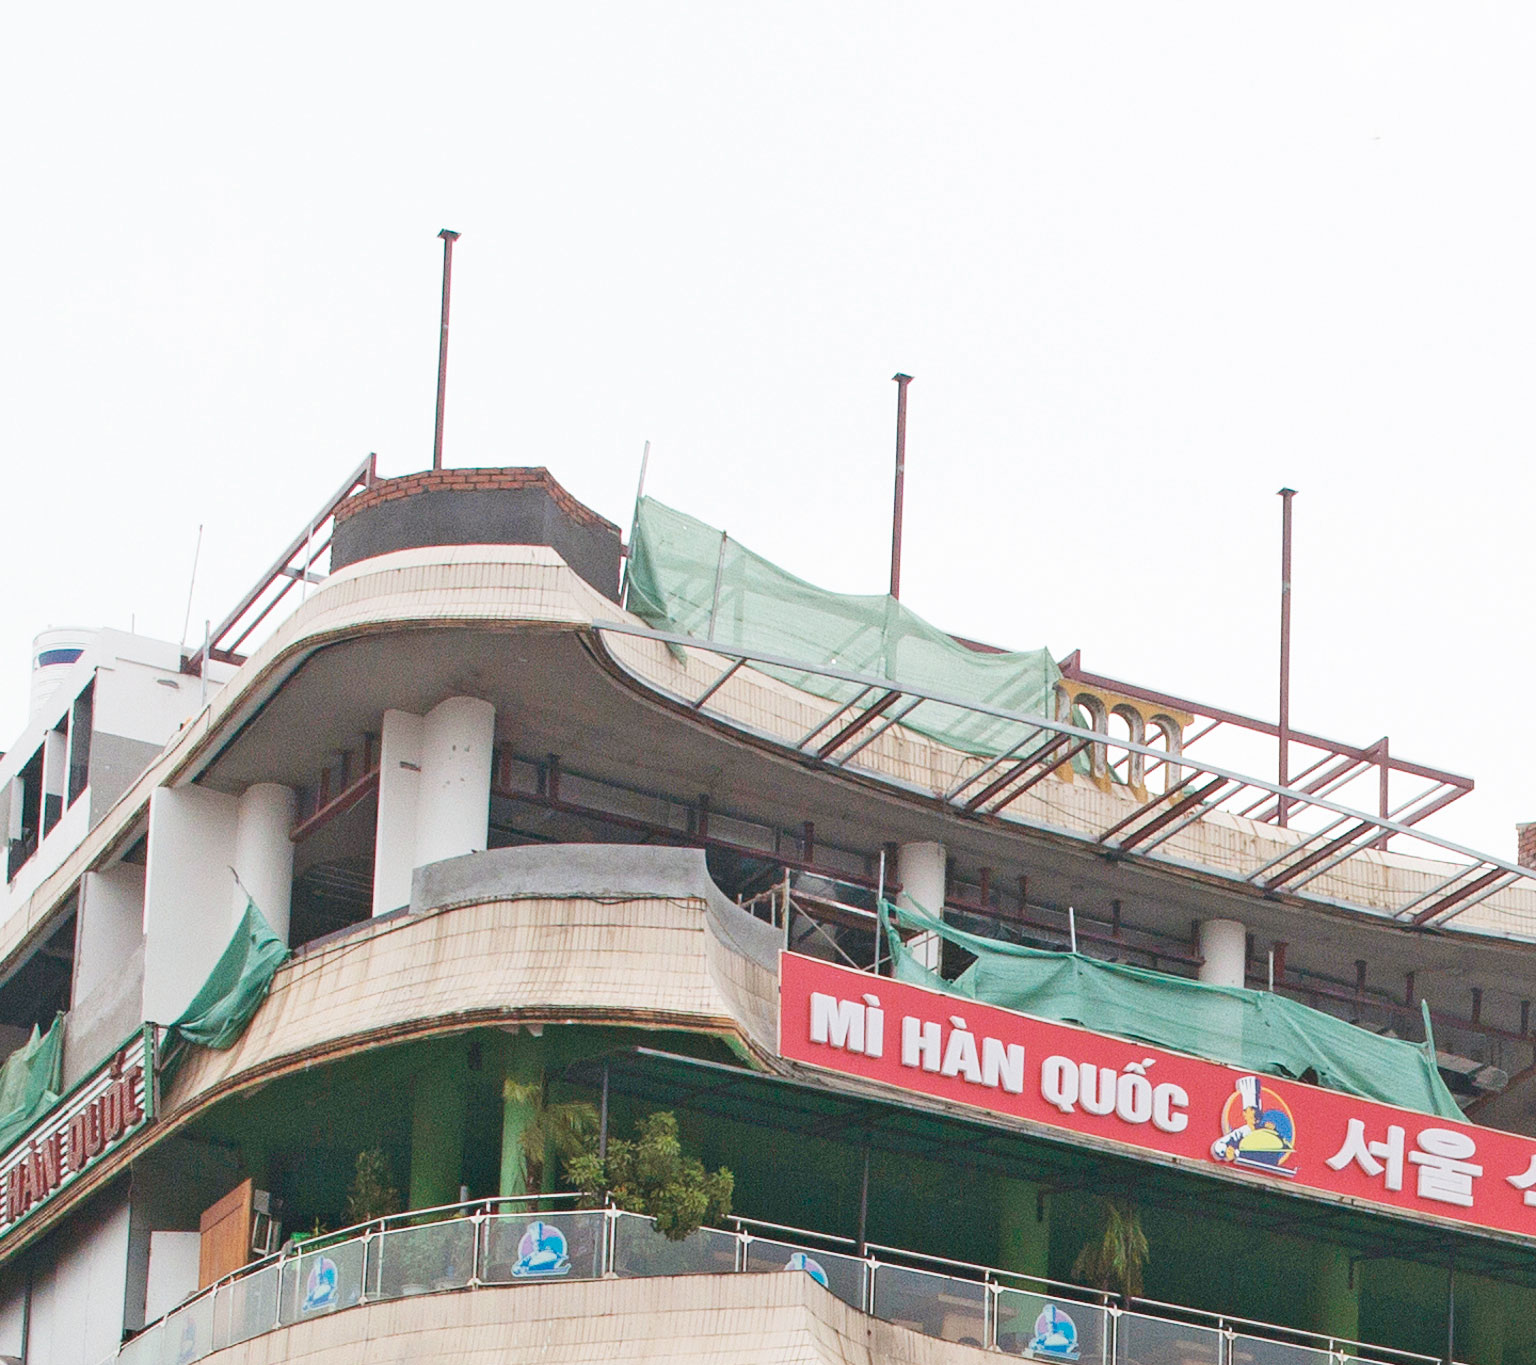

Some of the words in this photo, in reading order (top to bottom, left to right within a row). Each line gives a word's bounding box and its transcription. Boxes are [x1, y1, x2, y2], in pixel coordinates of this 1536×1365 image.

[810, 992, 884, 1058] MÌ
[901, 1015, 1025, 1094] HÀN
[1041, 1058, 1191, 1134] QUỐC
[6, 1132, 63, 1223] HÀN
[66, 1050, 145, 1173] QUỐC
[1324, 1118, 1484, 1207] 서울
